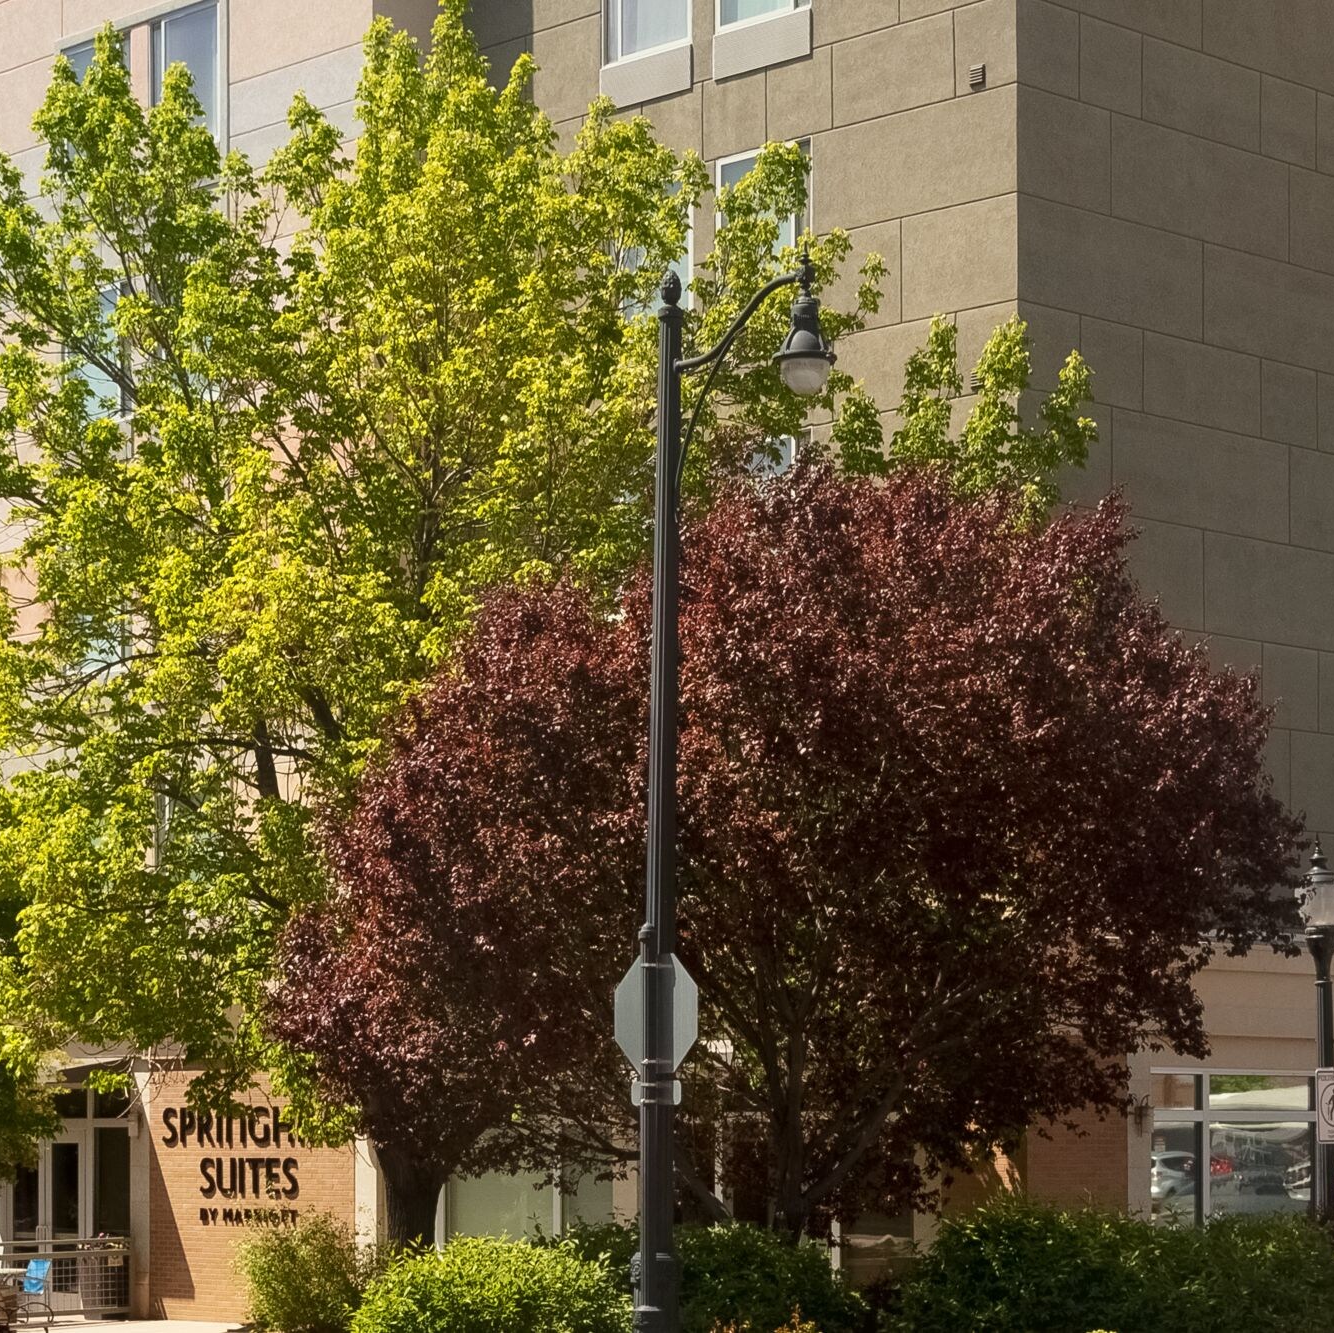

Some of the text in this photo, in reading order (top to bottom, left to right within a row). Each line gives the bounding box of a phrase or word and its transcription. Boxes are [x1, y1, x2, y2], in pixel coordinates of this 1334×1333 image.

[162, 1106, 305, 1147] SPRINGH
[199, 1157, 299, 1199] SUITES
[200, 1208, 218, 1225] BY
